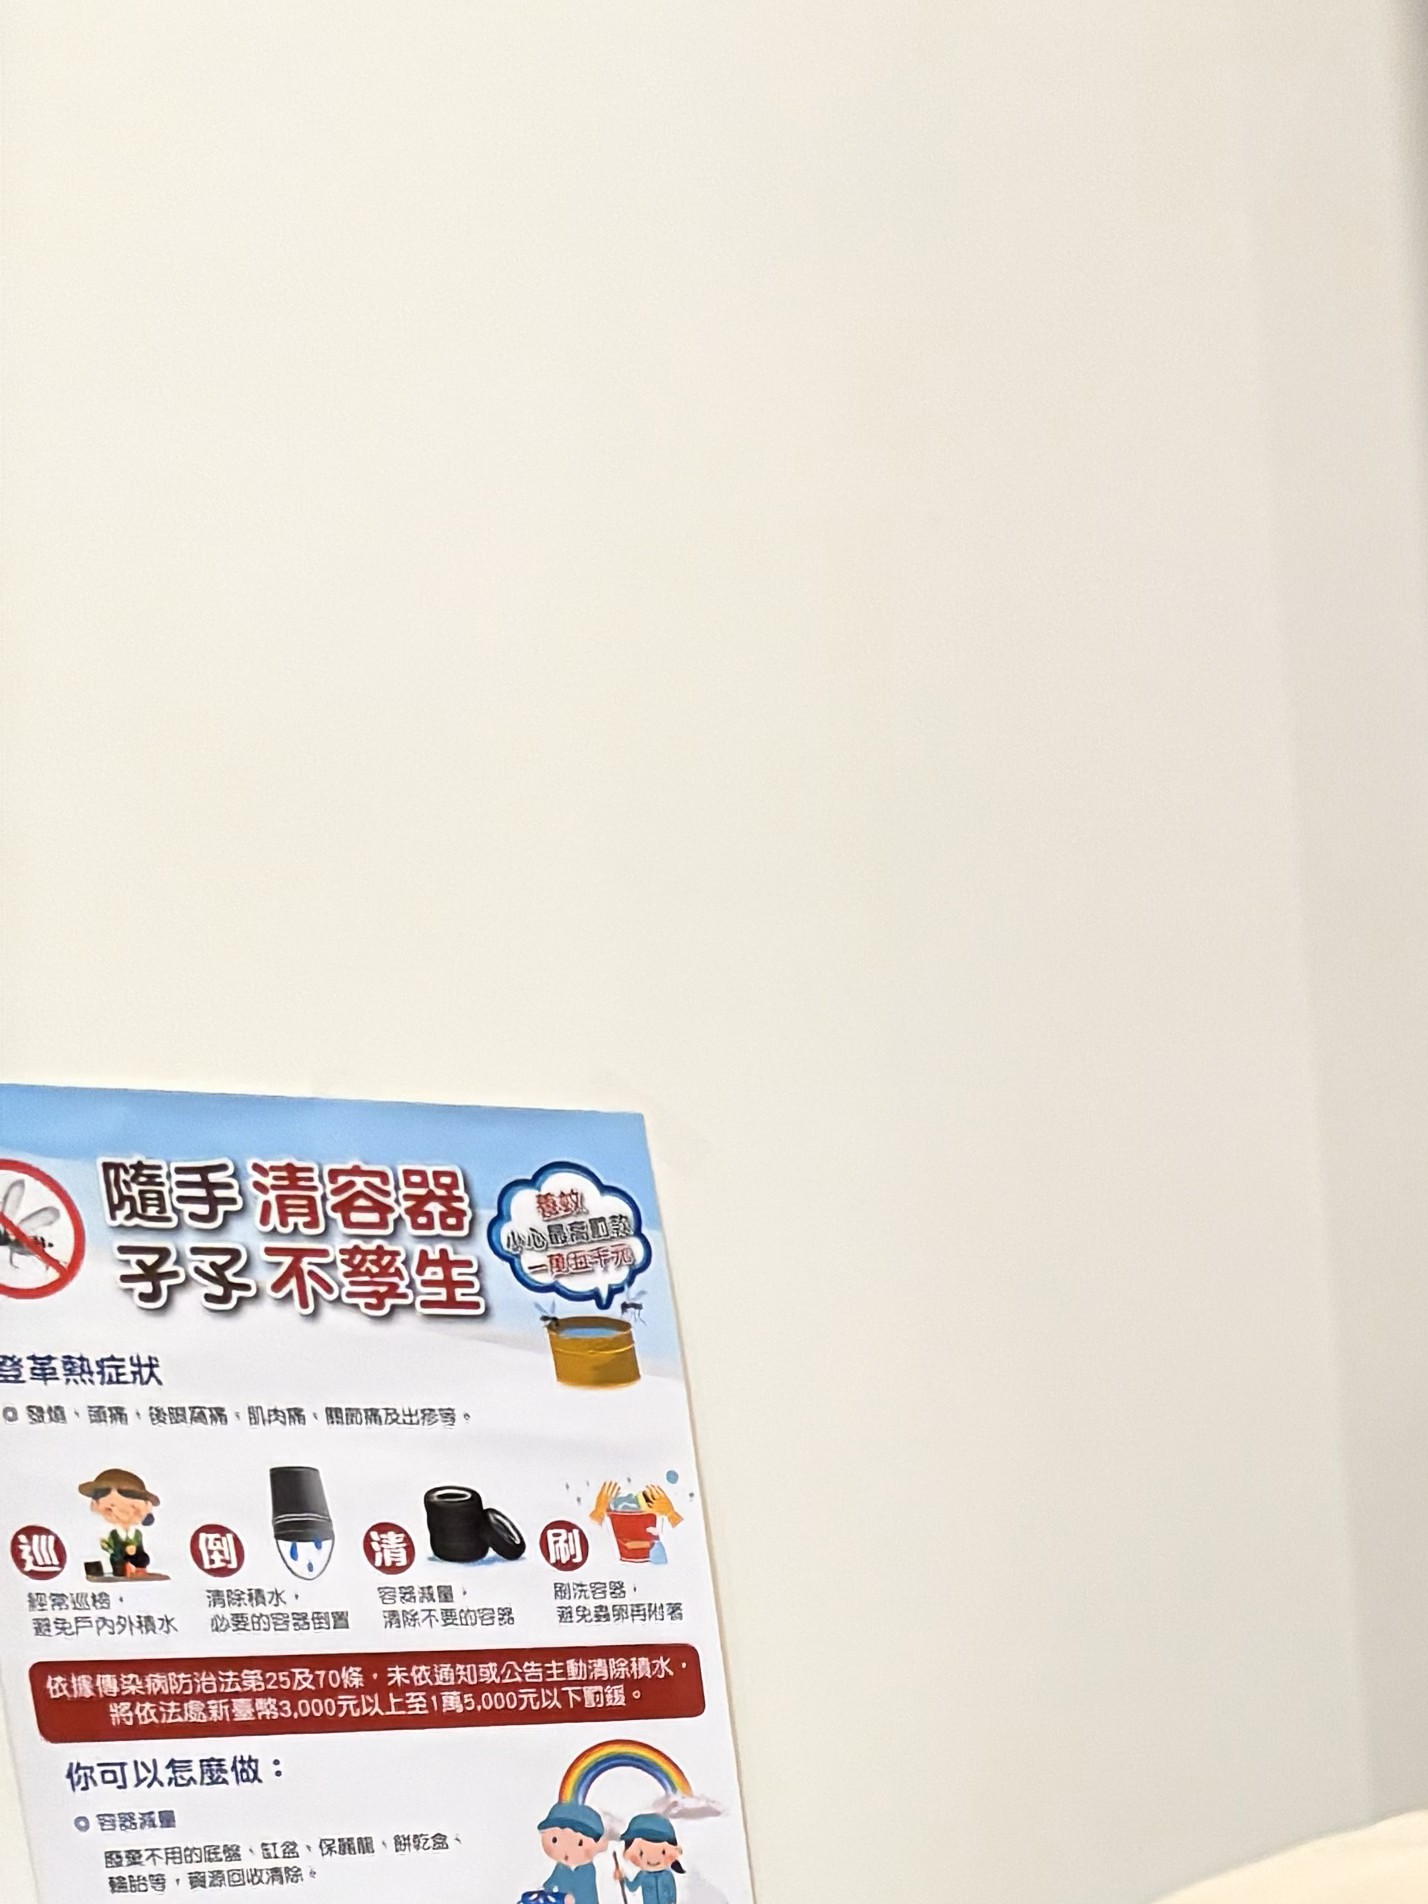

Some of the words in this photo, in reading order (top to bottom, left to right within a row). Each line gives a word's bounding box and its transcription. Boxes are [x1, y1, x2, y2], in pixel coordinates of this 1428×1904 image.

[17, 1534, 63, 1572] 巡
[199, 1532, 238, 1569] 倒
[369, 1530, 408, 1567] 清
[546, 1528, 583, 1564] 刷
